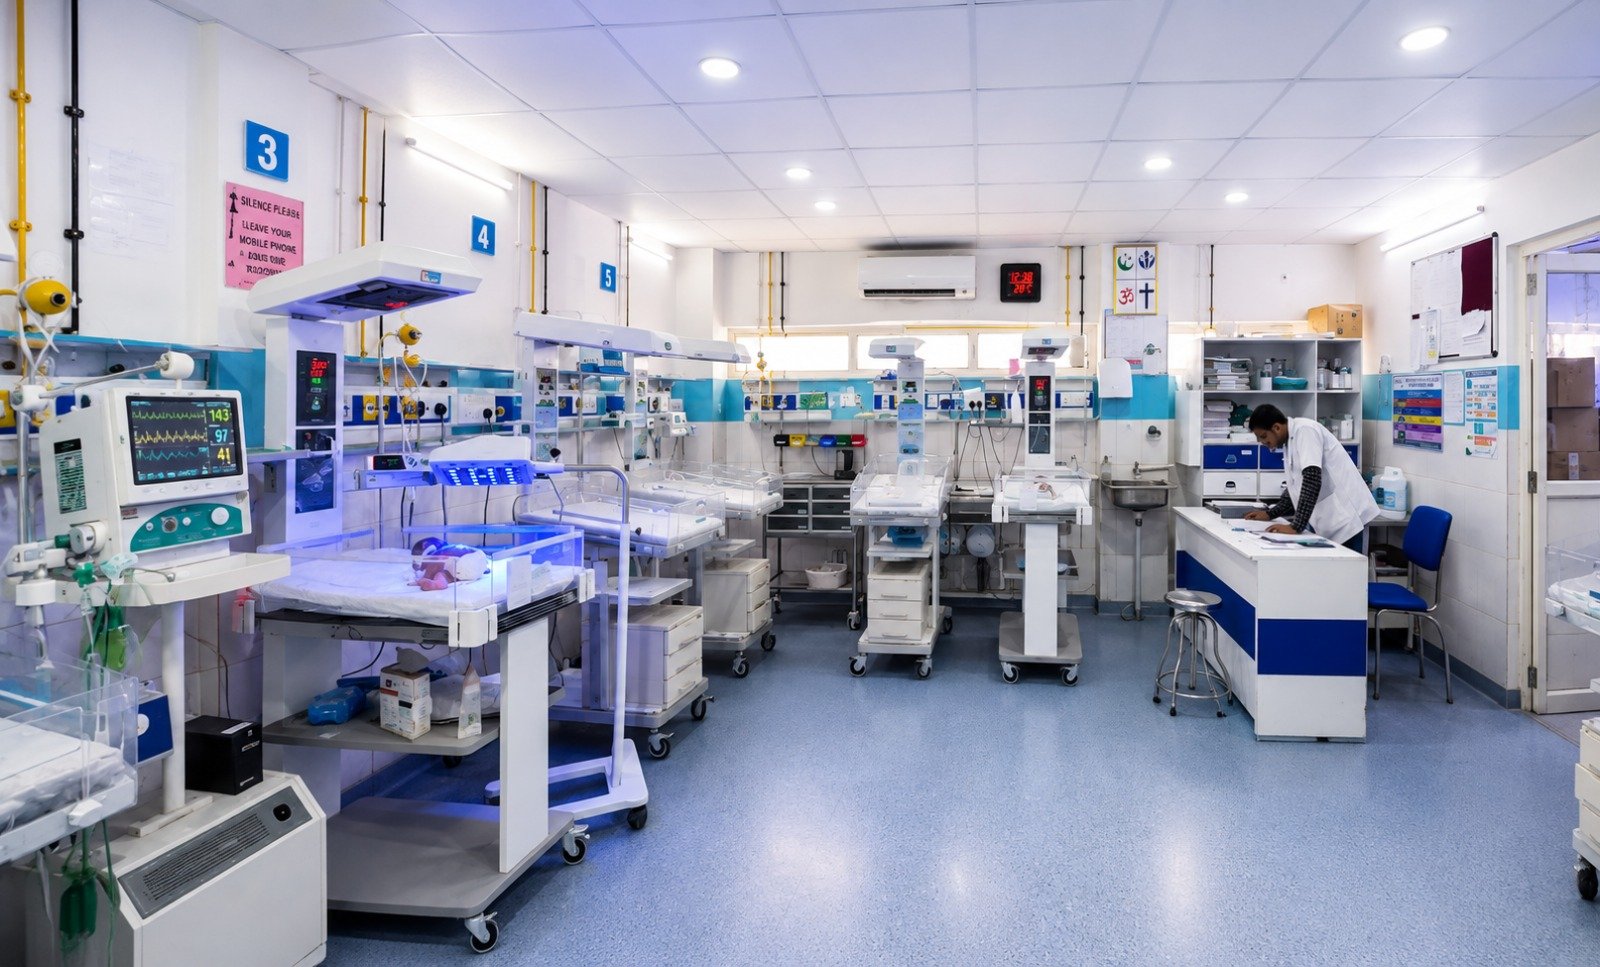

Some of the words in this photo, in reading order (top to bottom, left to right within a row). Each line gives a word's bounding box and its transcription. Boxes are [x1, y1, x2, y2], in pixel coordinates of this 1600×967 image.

[258, 133, 277, 171] 3
[241, 195, 272, 213] SILENCE
[271, 227, 292, 239] YOUR
[477, 224, 489, 250] 4
[239, 235, 269, 249] MOBILE
[605, 269, 612, 288] 5
[209, 409, 229, 421] 143
[215, 428, 228, 443] 97
